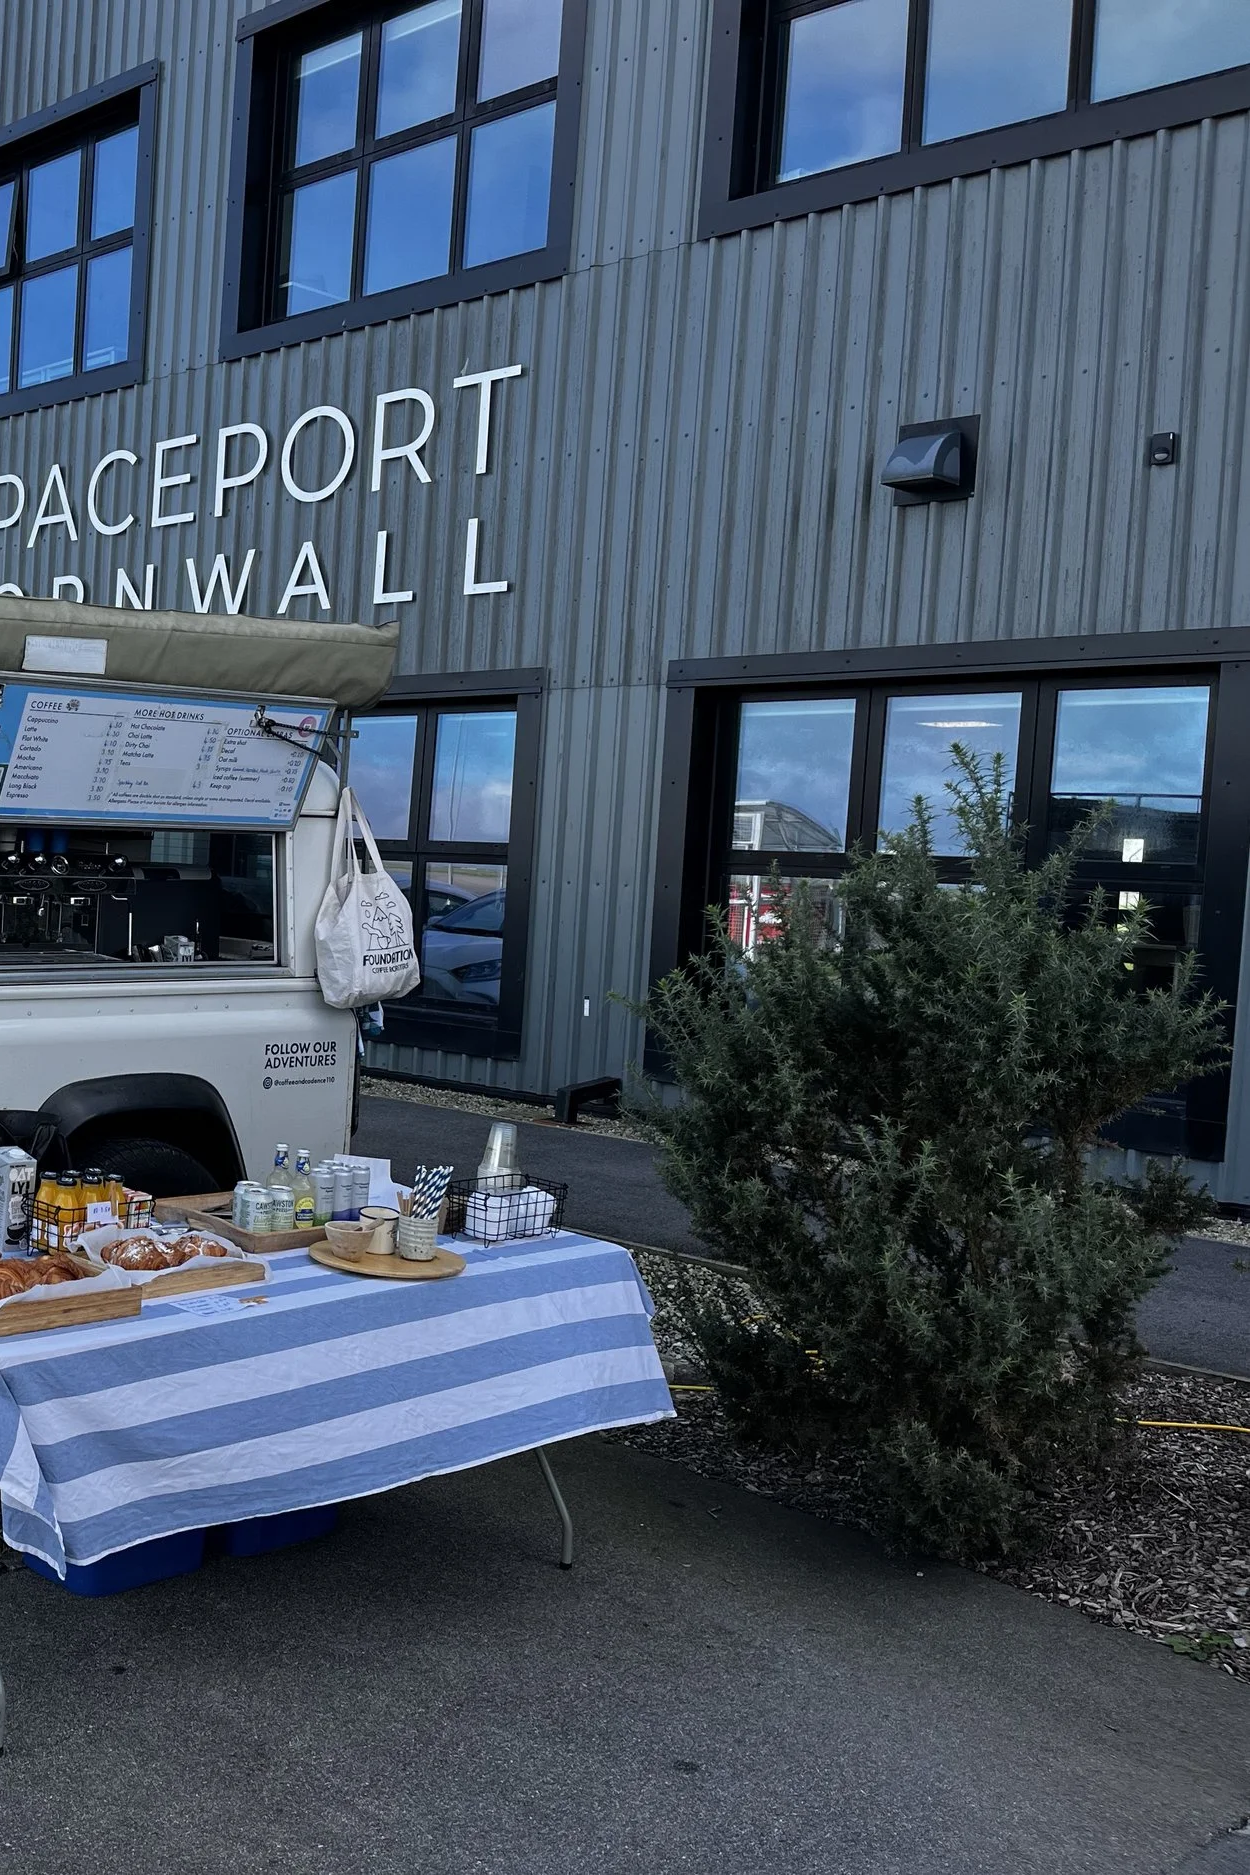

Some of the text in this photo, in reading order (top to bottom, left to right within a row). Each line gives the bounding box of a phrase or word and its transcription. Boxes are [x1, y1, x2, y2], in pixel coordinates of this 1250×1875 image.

[30, 700, 63, 711] COFFEE
[134, 709, 205, 721] MORE HOT DRINKS
[26, 716, 59, 724] Cappuccino
[140, 723, 166, 731] Chocolate
[125, 741, 138, 749] Dirty
[215, 765, 231, 773] Syrups
[8, 783, 22, 791] Long
[6, 792, 29, 800] Espresso
[362, 948, 414, 967] FOUNDATION
[264, 1041, 337, 1056] FOLLOW OUR
[264, 1054, 337, 1070] ADVENTURES
[272, 1200, 293, 1208] AWSTON
